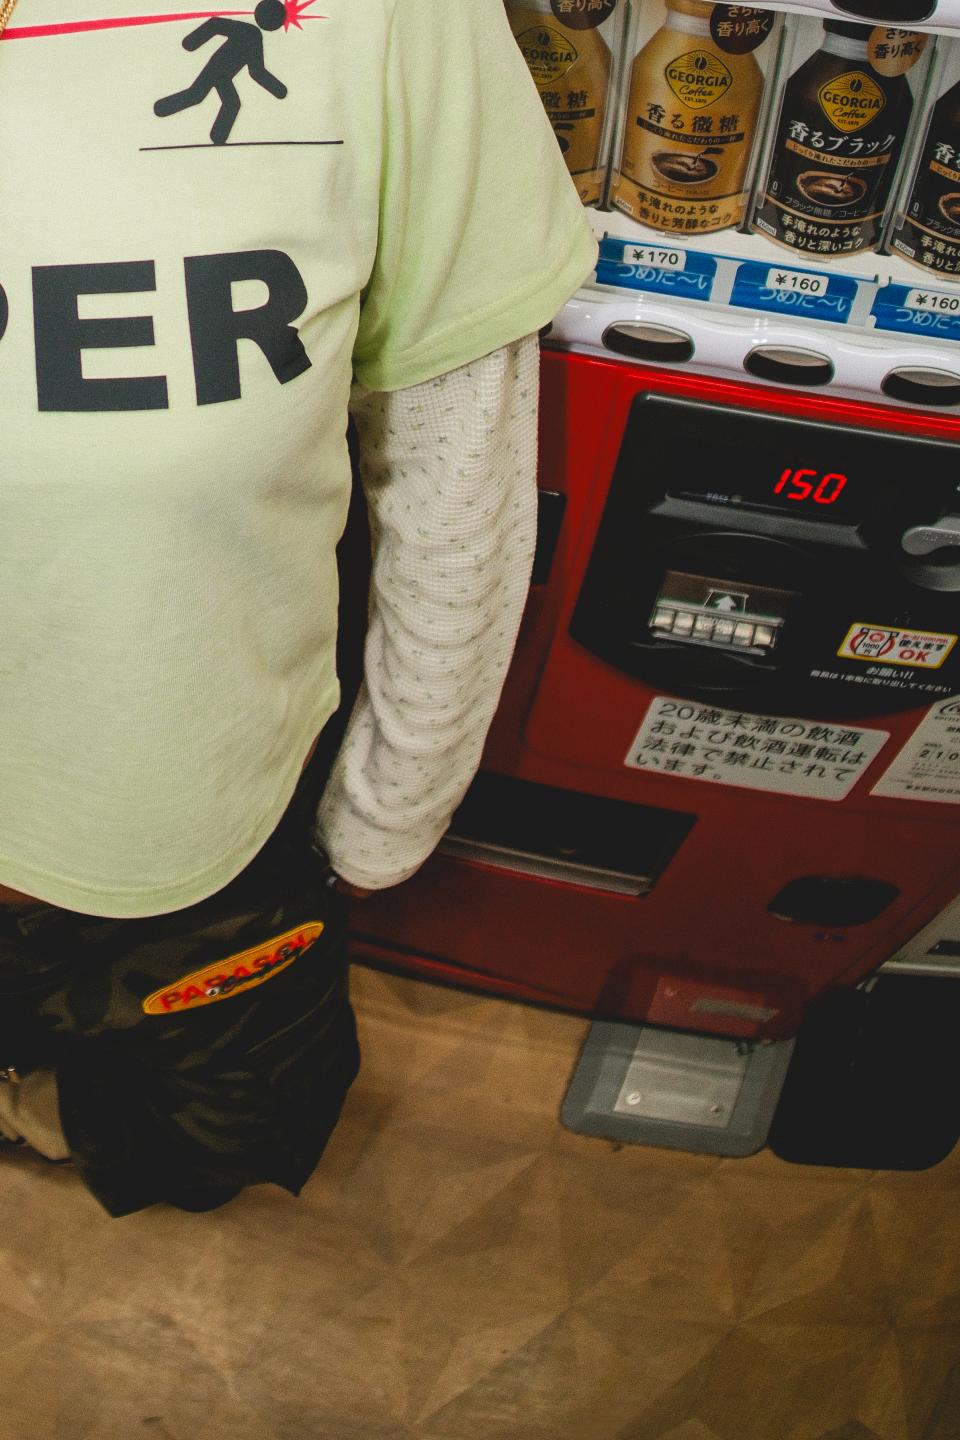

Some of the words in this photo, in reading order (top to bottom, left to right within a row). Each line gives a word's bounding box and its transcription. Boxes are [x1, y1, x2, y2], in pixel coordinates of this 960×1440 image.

[716, 19, 769, 37] 香り高く
[523, 47, 574, 63] EORGIA
[874, 41, 921, 60] 香り高く
[668, 69, 728, 87] GEORGIA
[678, 85, 715, 97] Coffee
[823, 91, 881, 110] GEORGIA
[647, 102, 741, 134] 香る微糖
[832, 107, 867, 119] Coffee
[789, 119, 897, 154] 香るブラック
[781, 213, 862, 236] 手淹れのような
[784, 230, 863, 251] 香りと深いコク
[632, 249, 678, 266] ¥170
[775, 273, 821, 293] ¥160
[916, 293, 959, 311] ¥160
[774, 468, 847, 504] 150
[899, 650, 931, 663] OK
[658, 703, 864, 747] 20歳未満の飲酒
[650, 720, 867, 766] および飲酒運転は
[636, 753, 722, 780] います。
[642, 735, 857, 782] 法律で禁止されて
